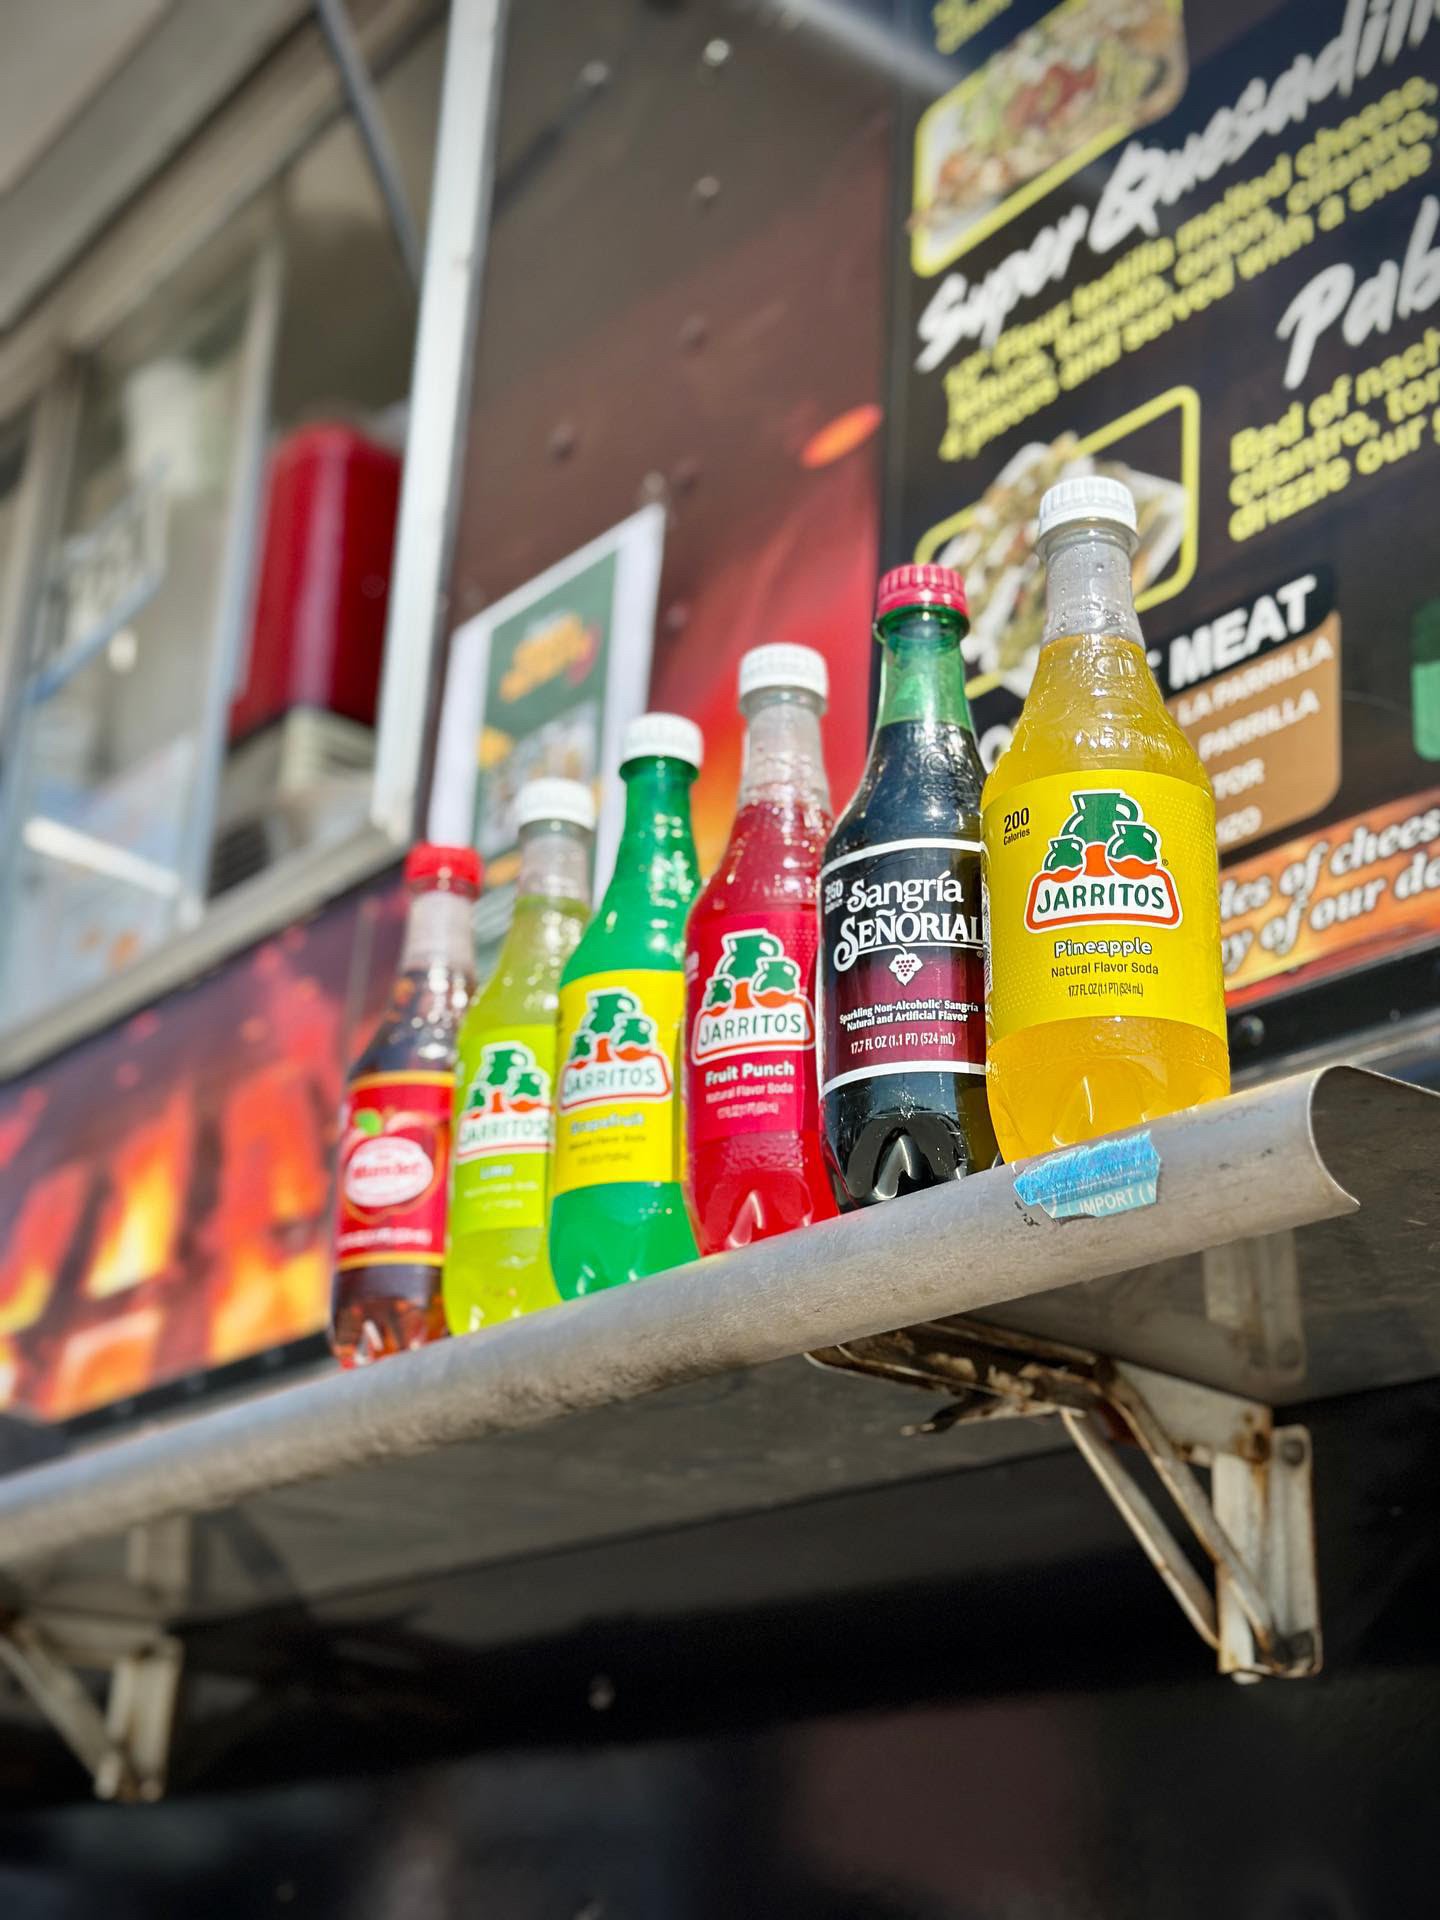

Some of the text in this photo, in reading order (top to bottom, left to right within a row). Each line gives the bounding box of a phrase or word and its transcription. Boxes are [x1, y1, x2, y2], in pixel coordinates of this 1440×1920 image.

[915, 0, 1440, 372] Super Quesadill
[1059, 328, 1122, 390] and
[1317, 194, 1346, 232] a
[1349, 142, 1432, 212] side
[1230, 401, 1305, 473] Bed
[1308, 373, 1352, 429] of
[1229, 410, 1381, 507] cilantro,
[1356, 415, 1427, 475] our
[1168, 573, 1317, 691] MEAT
[1177, 691, 1212, 727] LA
[1212, 636, 1334, 710] PARRILLA
[1198, 688, 1320, 762] PARRILLA
[1003, 807, 1030, 833] 200
[1003, 829, 1030, 846] Calories
[1279, 841, 1330, 898] of
[847, 870, 964, 913] Sangría
[1037, 883, 1165, 914] JARRITOS
[1260, 889, 1311, 957] of
[1310, 878, 1387, 931] our
[833, 908, 984, 972] SEÑORIAL
[1054, 937, 1152, 958] Pineapple
[1051, 961, 1159, 978] Natural Flavor Soda
[1068, 985, 1078, 997] 17.7
[1079, 984, 1088, 996] FL
[1088, 983, 1097, 995] OZ
[1108, 982, 1119, 996] PT)
[1119, 982, 1131, 996] (524
[1132, 983, 1144, 997] mL)
[840, 1007, 873, 1025] Sparkling
[944, 1000, 979, 1013] Sangría
[847, 1010, 968, 1032] Natural and Artificial Flavor
[700, 1013, 802, 1046] JARRITOS
[851, 1032, 956, 1055] 17.7 FL OZ (1.1 PT) (524 mL)
[562, 1067, 657, 1098] JARRITOS
[705, 1059, 795, 1087] Fruit Punch
[736, 1085, 766, 1098] Flavor
[767, 1082, 794, 1095] Soda
[1080, 1188, 1134, 1214] IMPORT
